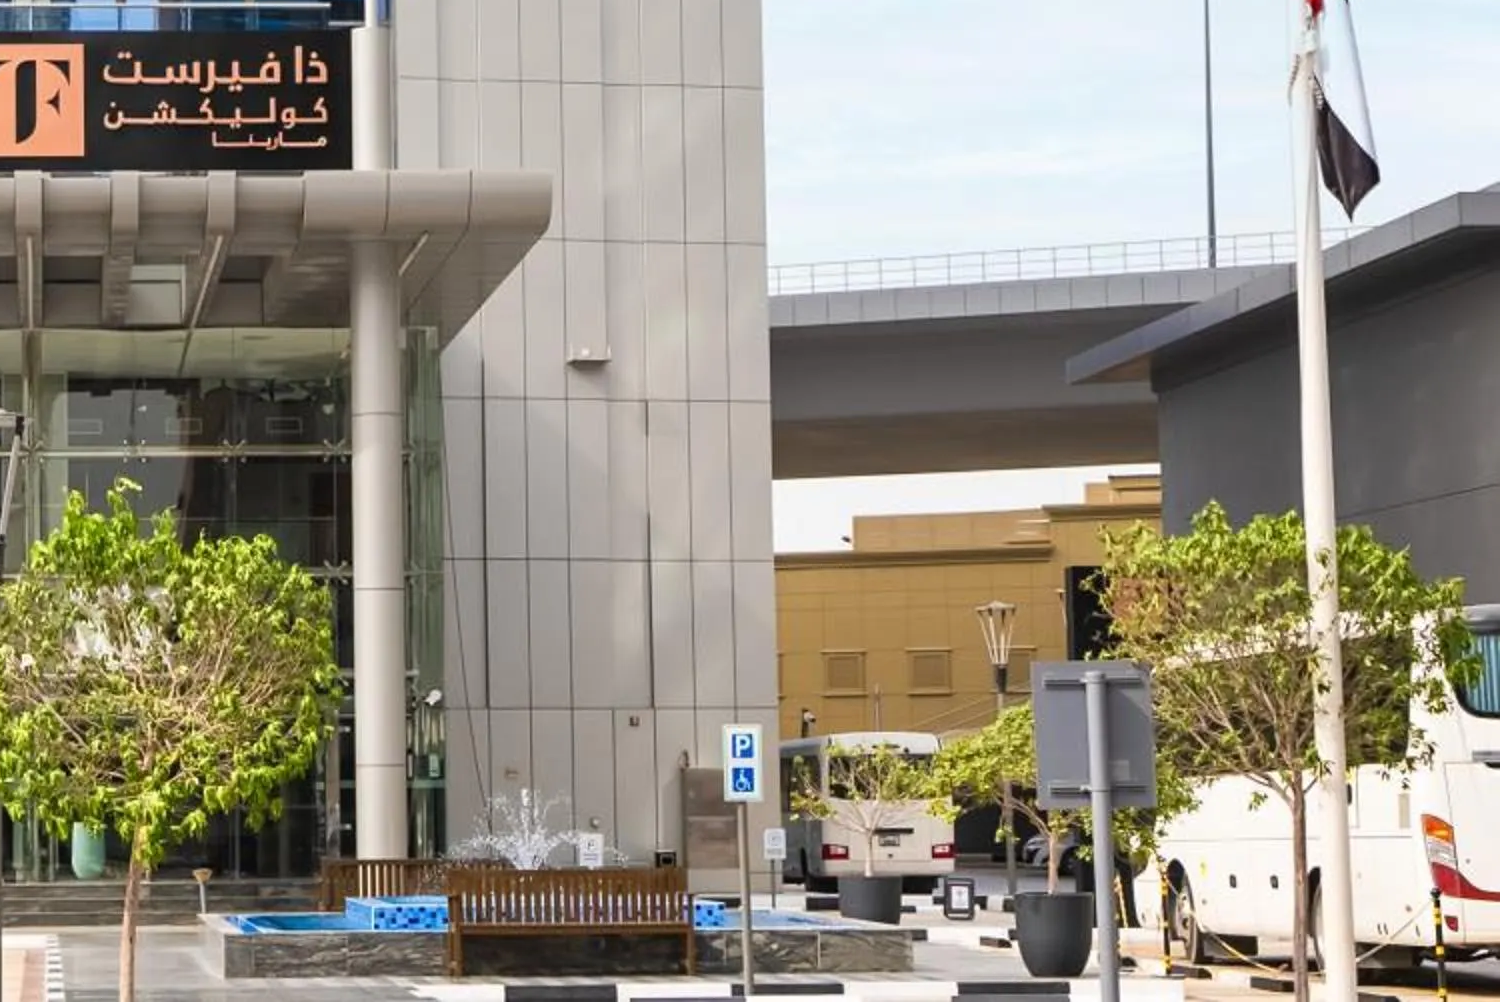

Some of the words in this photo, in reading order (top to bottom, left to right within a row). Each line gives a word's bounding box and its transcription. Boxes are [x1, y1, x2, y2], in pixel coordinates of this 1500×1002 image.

[102, 51, 282, 93] فيرست
[294, 45, 329, 84] ذا
[102, 97, 329, 130] كوليكشن
[735, 735, 751, 758] P
